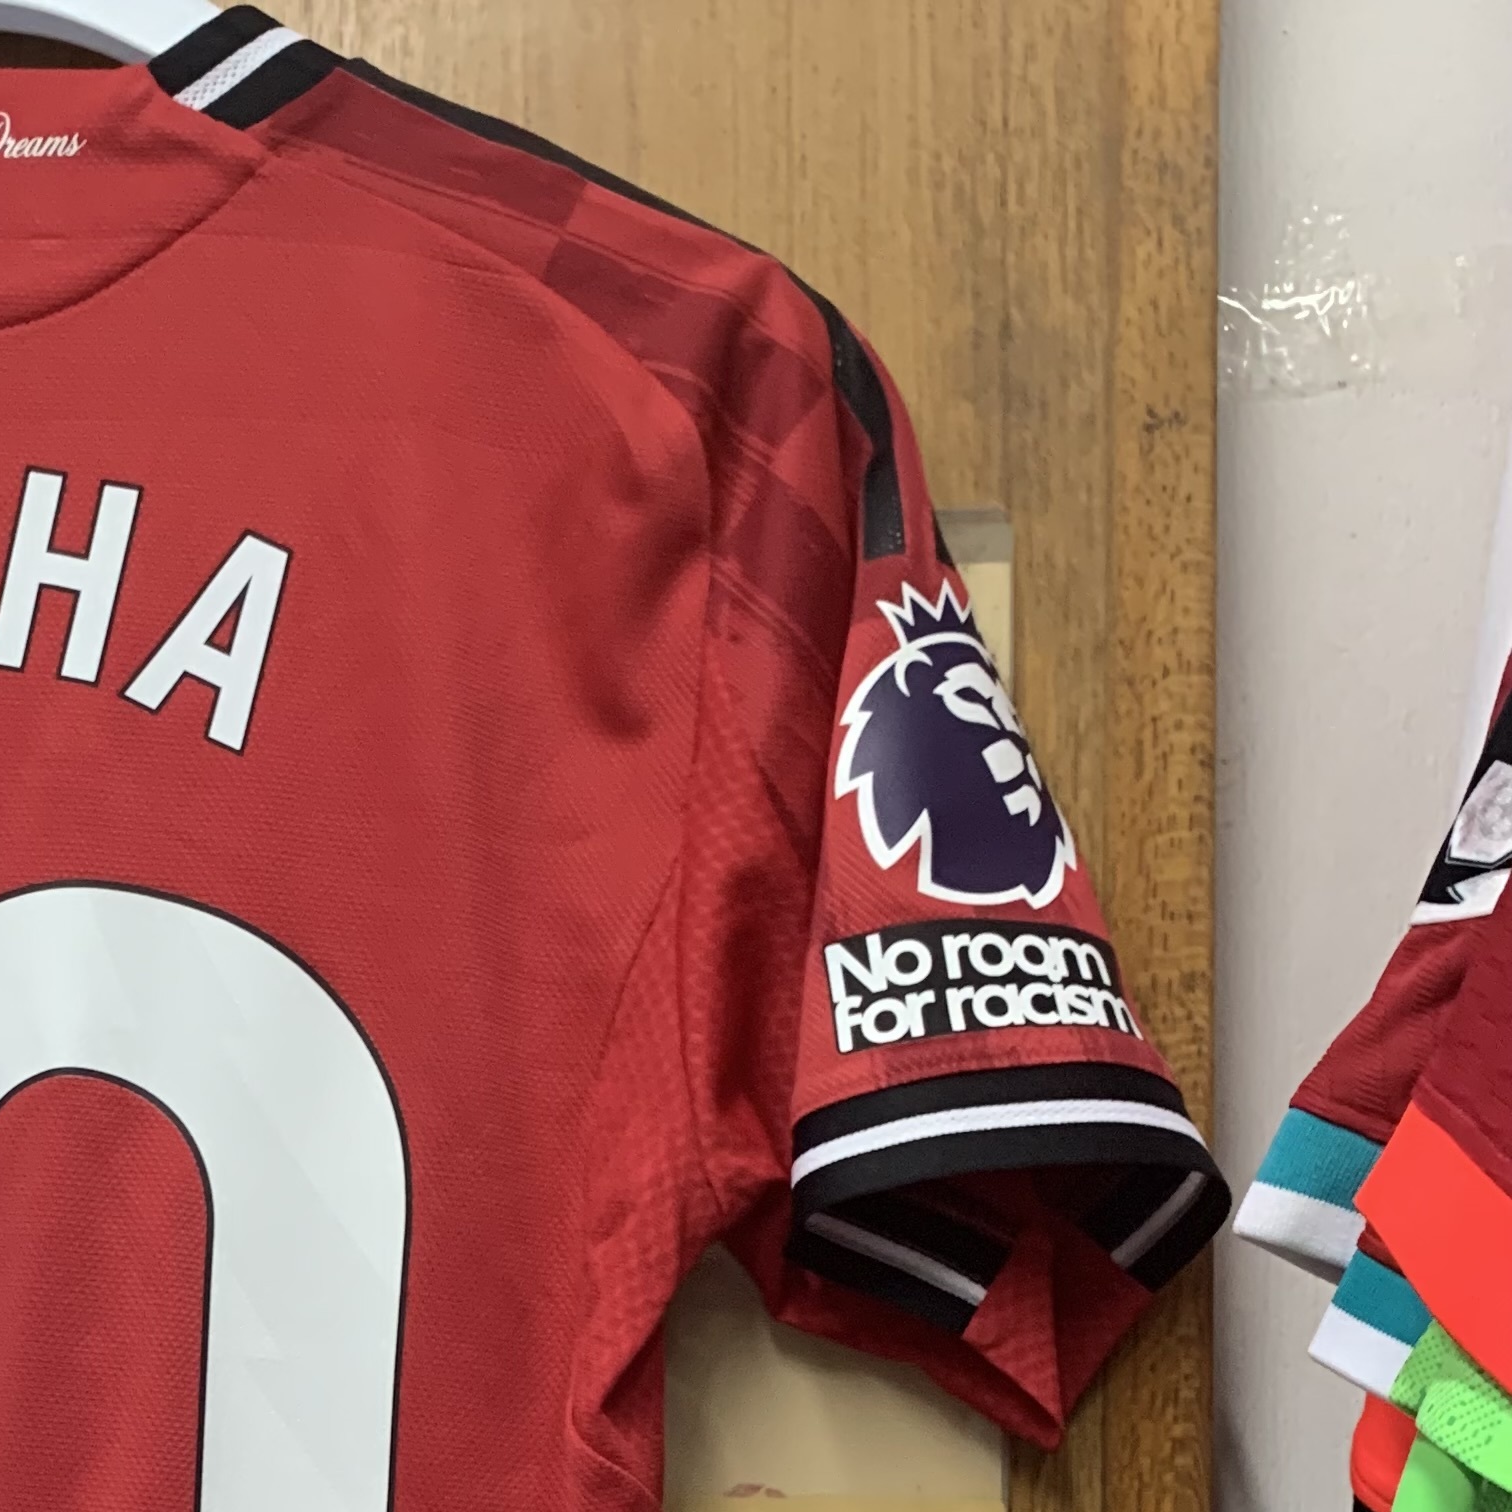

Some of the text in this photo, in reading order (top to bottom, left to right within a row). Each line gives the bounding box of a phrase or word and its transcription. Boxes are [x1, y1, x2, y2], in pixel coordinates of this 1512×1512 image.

[824, 932, 1112, 1004] No room
[834, 982, 1145, 1054] for racism
